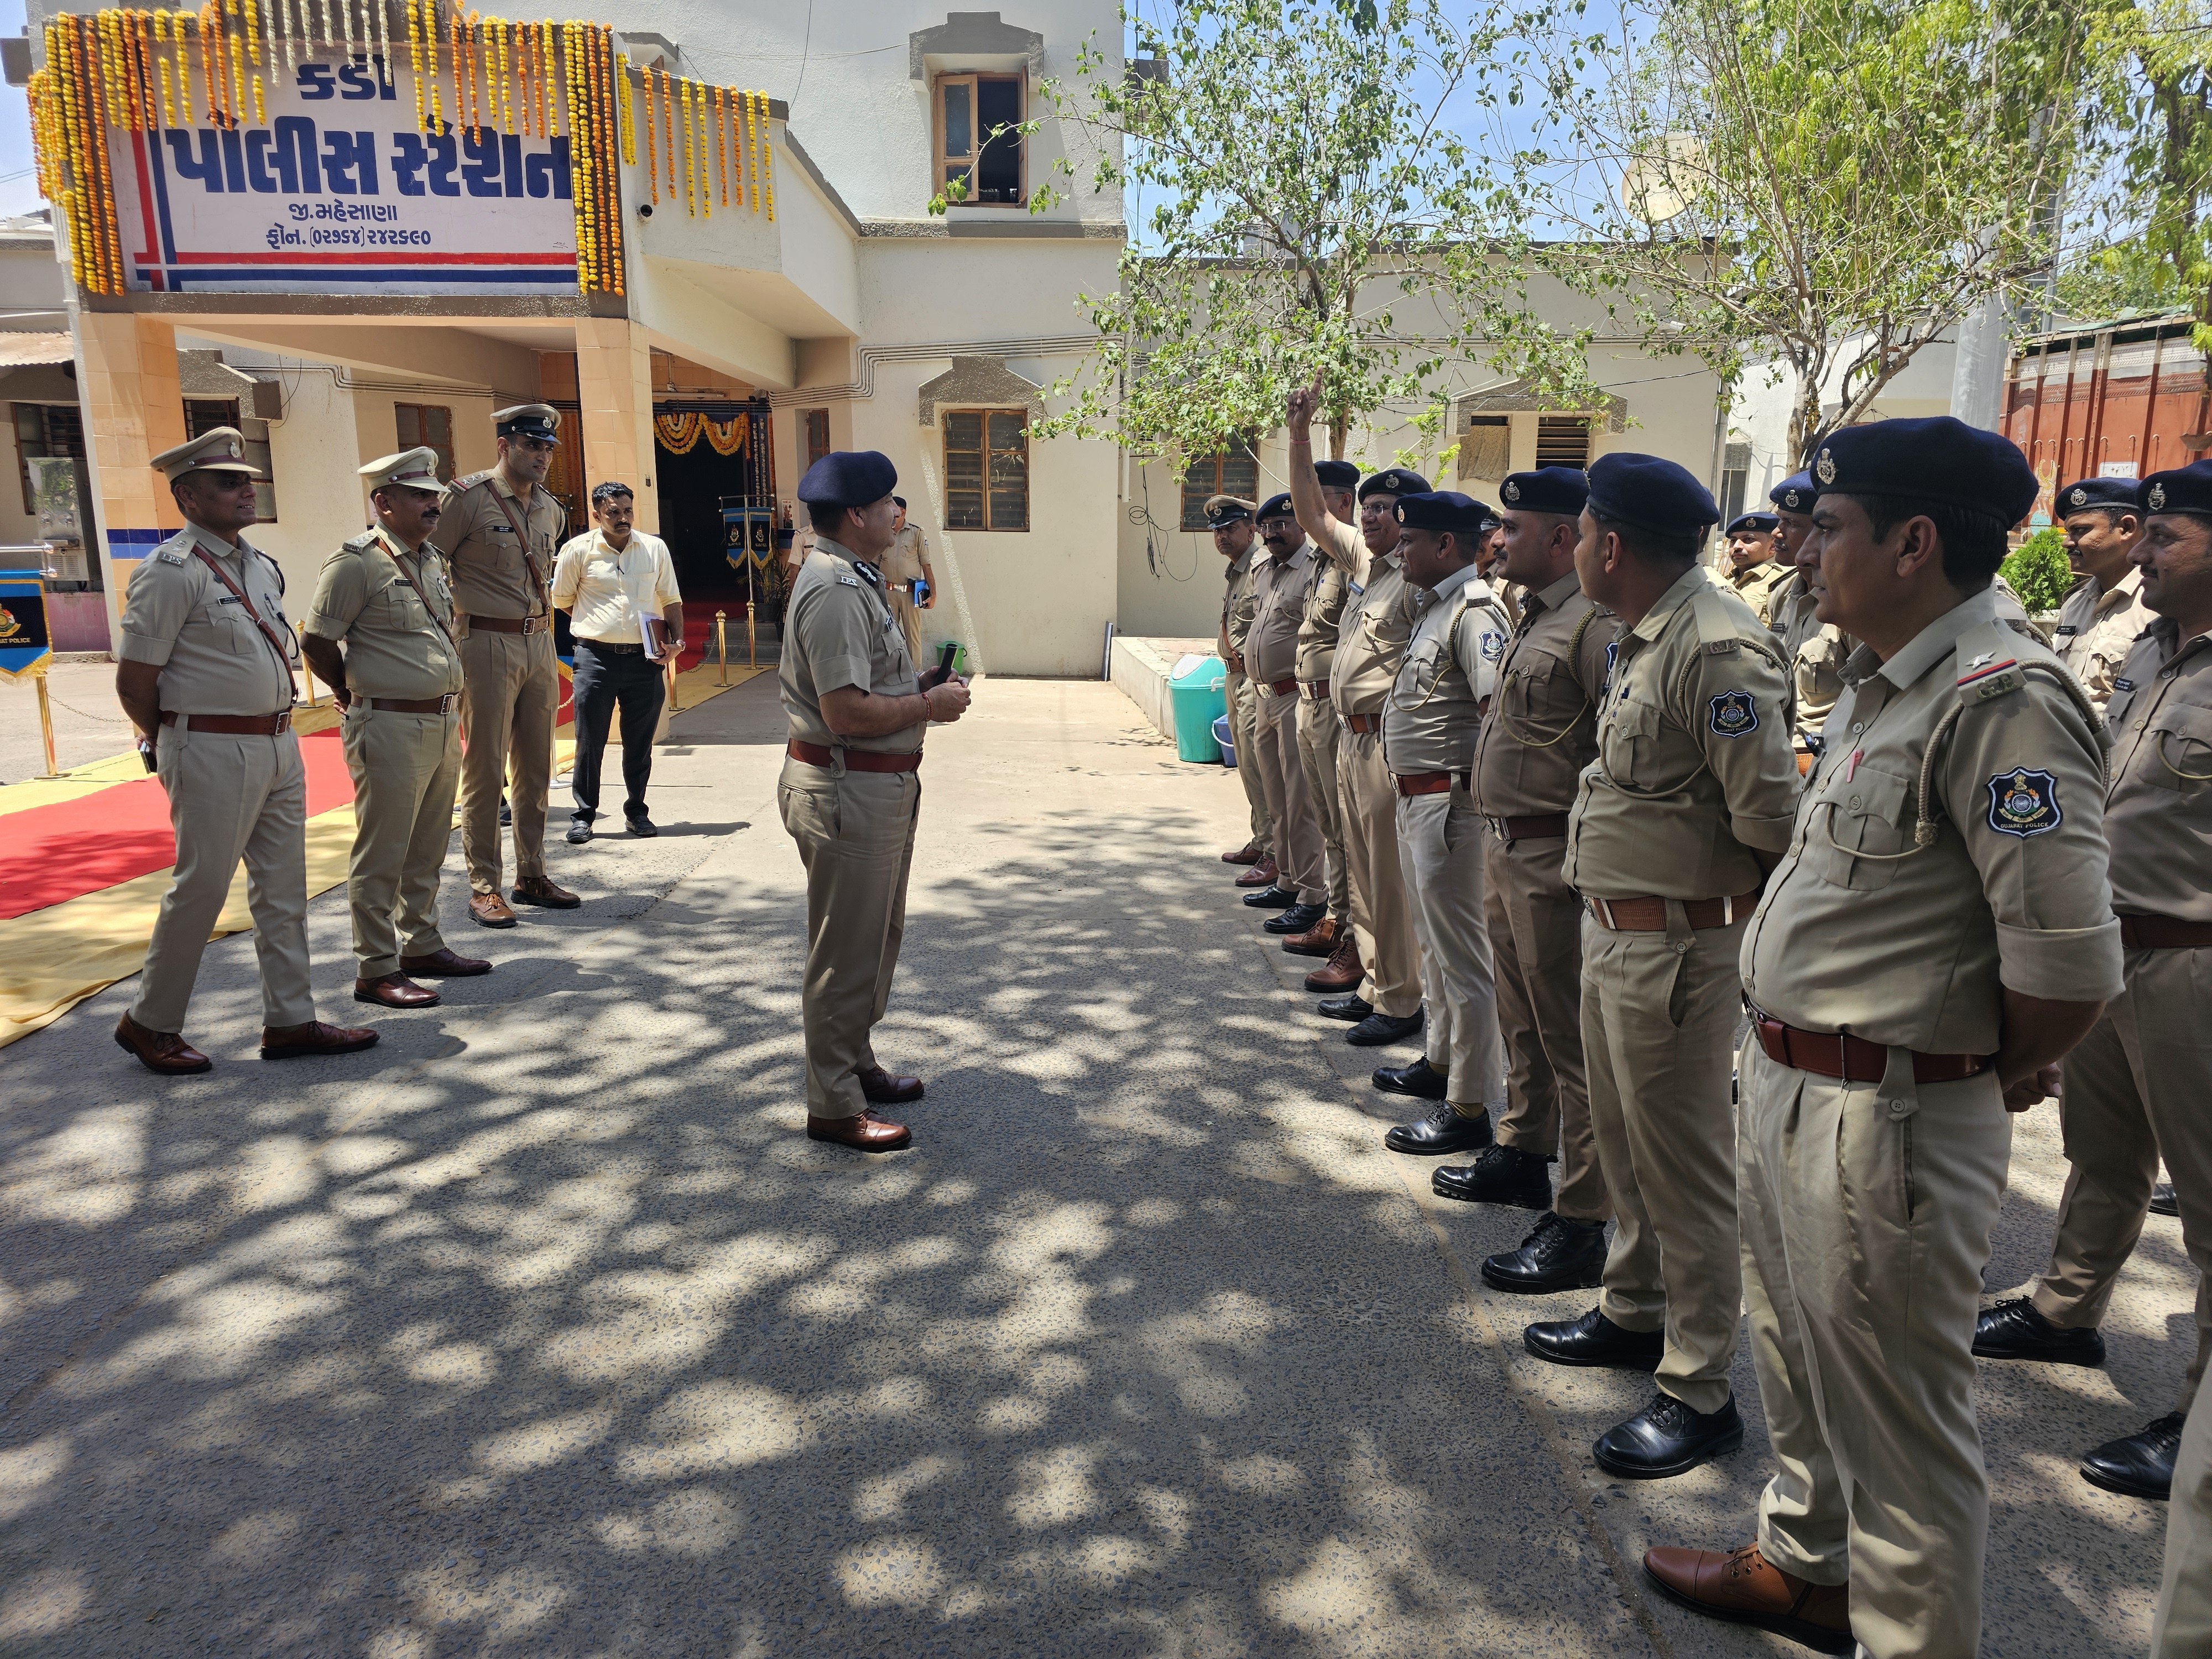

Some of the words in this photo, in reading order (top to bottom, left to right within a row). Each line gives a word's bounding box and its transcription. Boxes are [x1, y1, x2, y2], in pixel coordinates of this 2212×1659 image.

[296, 54, 397, 101] કડી
[164, 108, 379, 195] પોલીસ
[390, 113, 572, 200] સ્ટેશન
